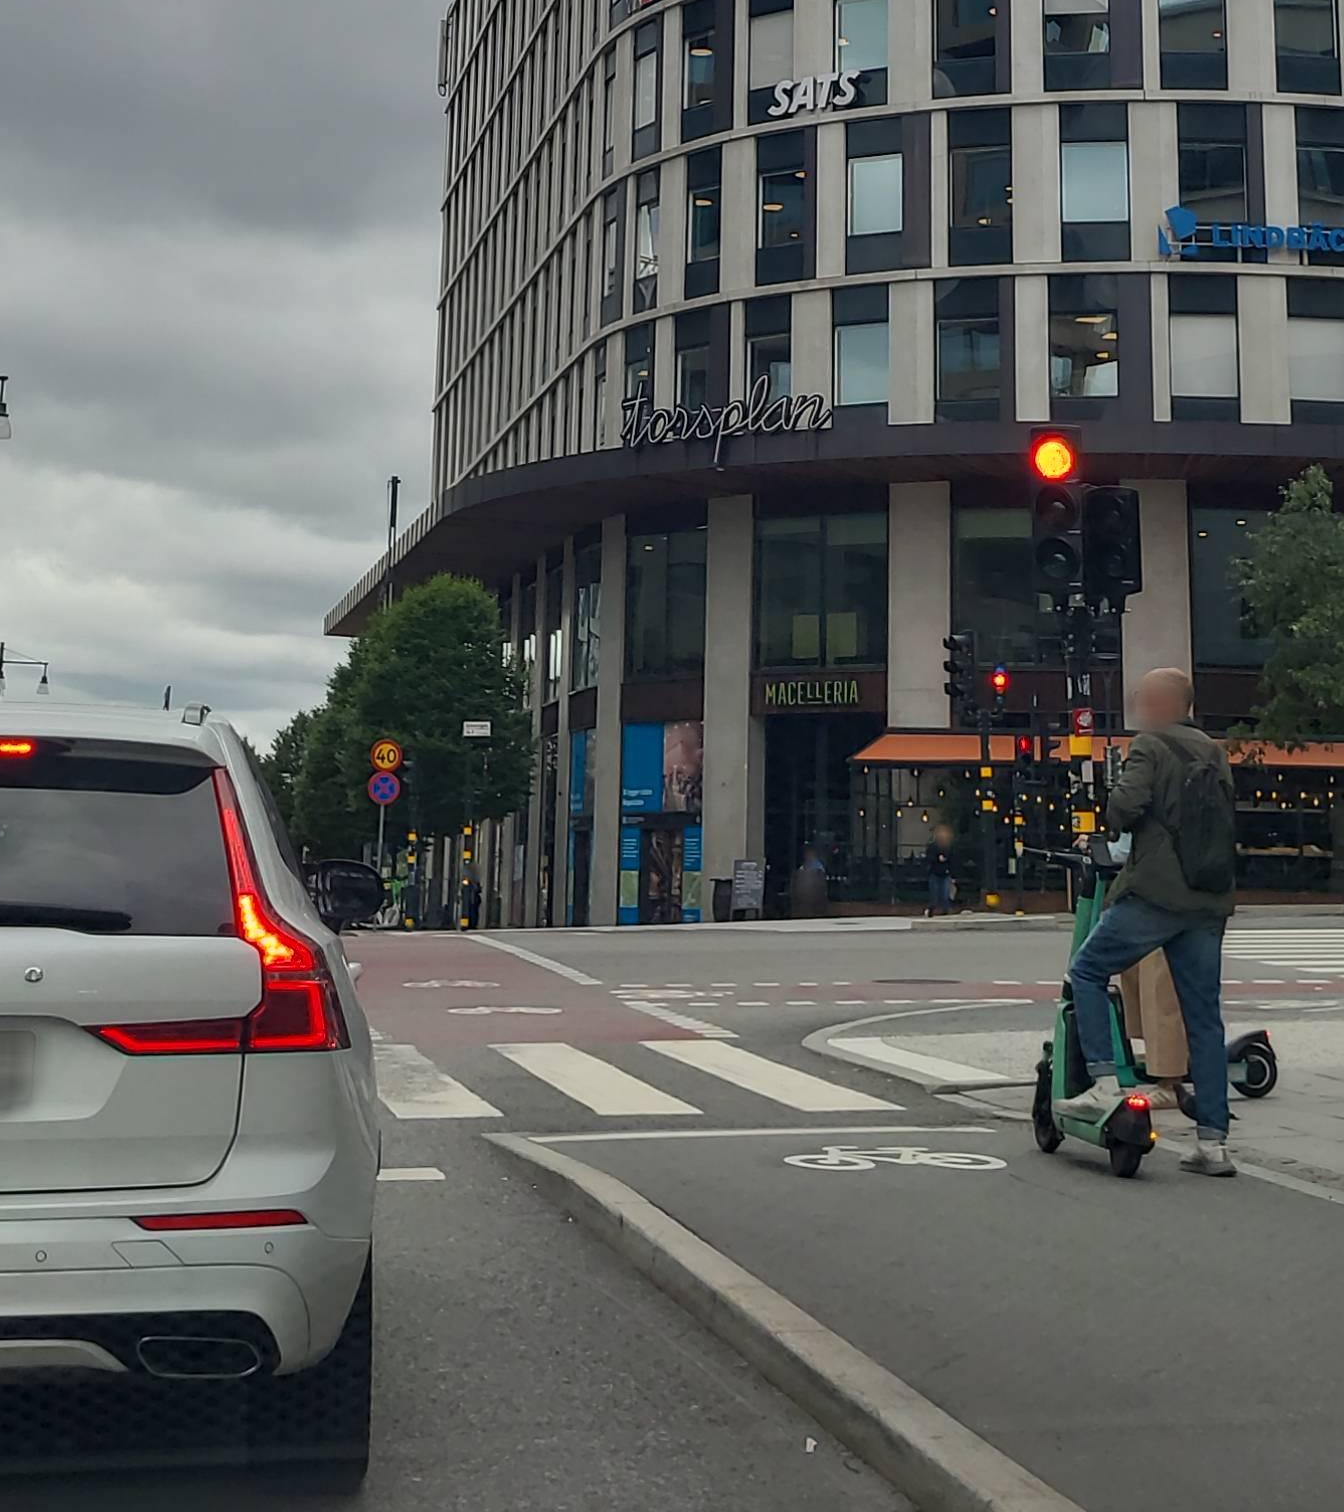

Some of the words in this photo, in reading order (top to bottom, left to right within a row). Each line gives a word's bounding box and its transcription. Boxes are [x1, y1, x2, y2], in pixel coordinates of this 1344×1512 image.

[767, 70, 860, 117] SATS
[765, 680, 859, 705] MACELLERIA
[376, 748, 397, 764] 40
